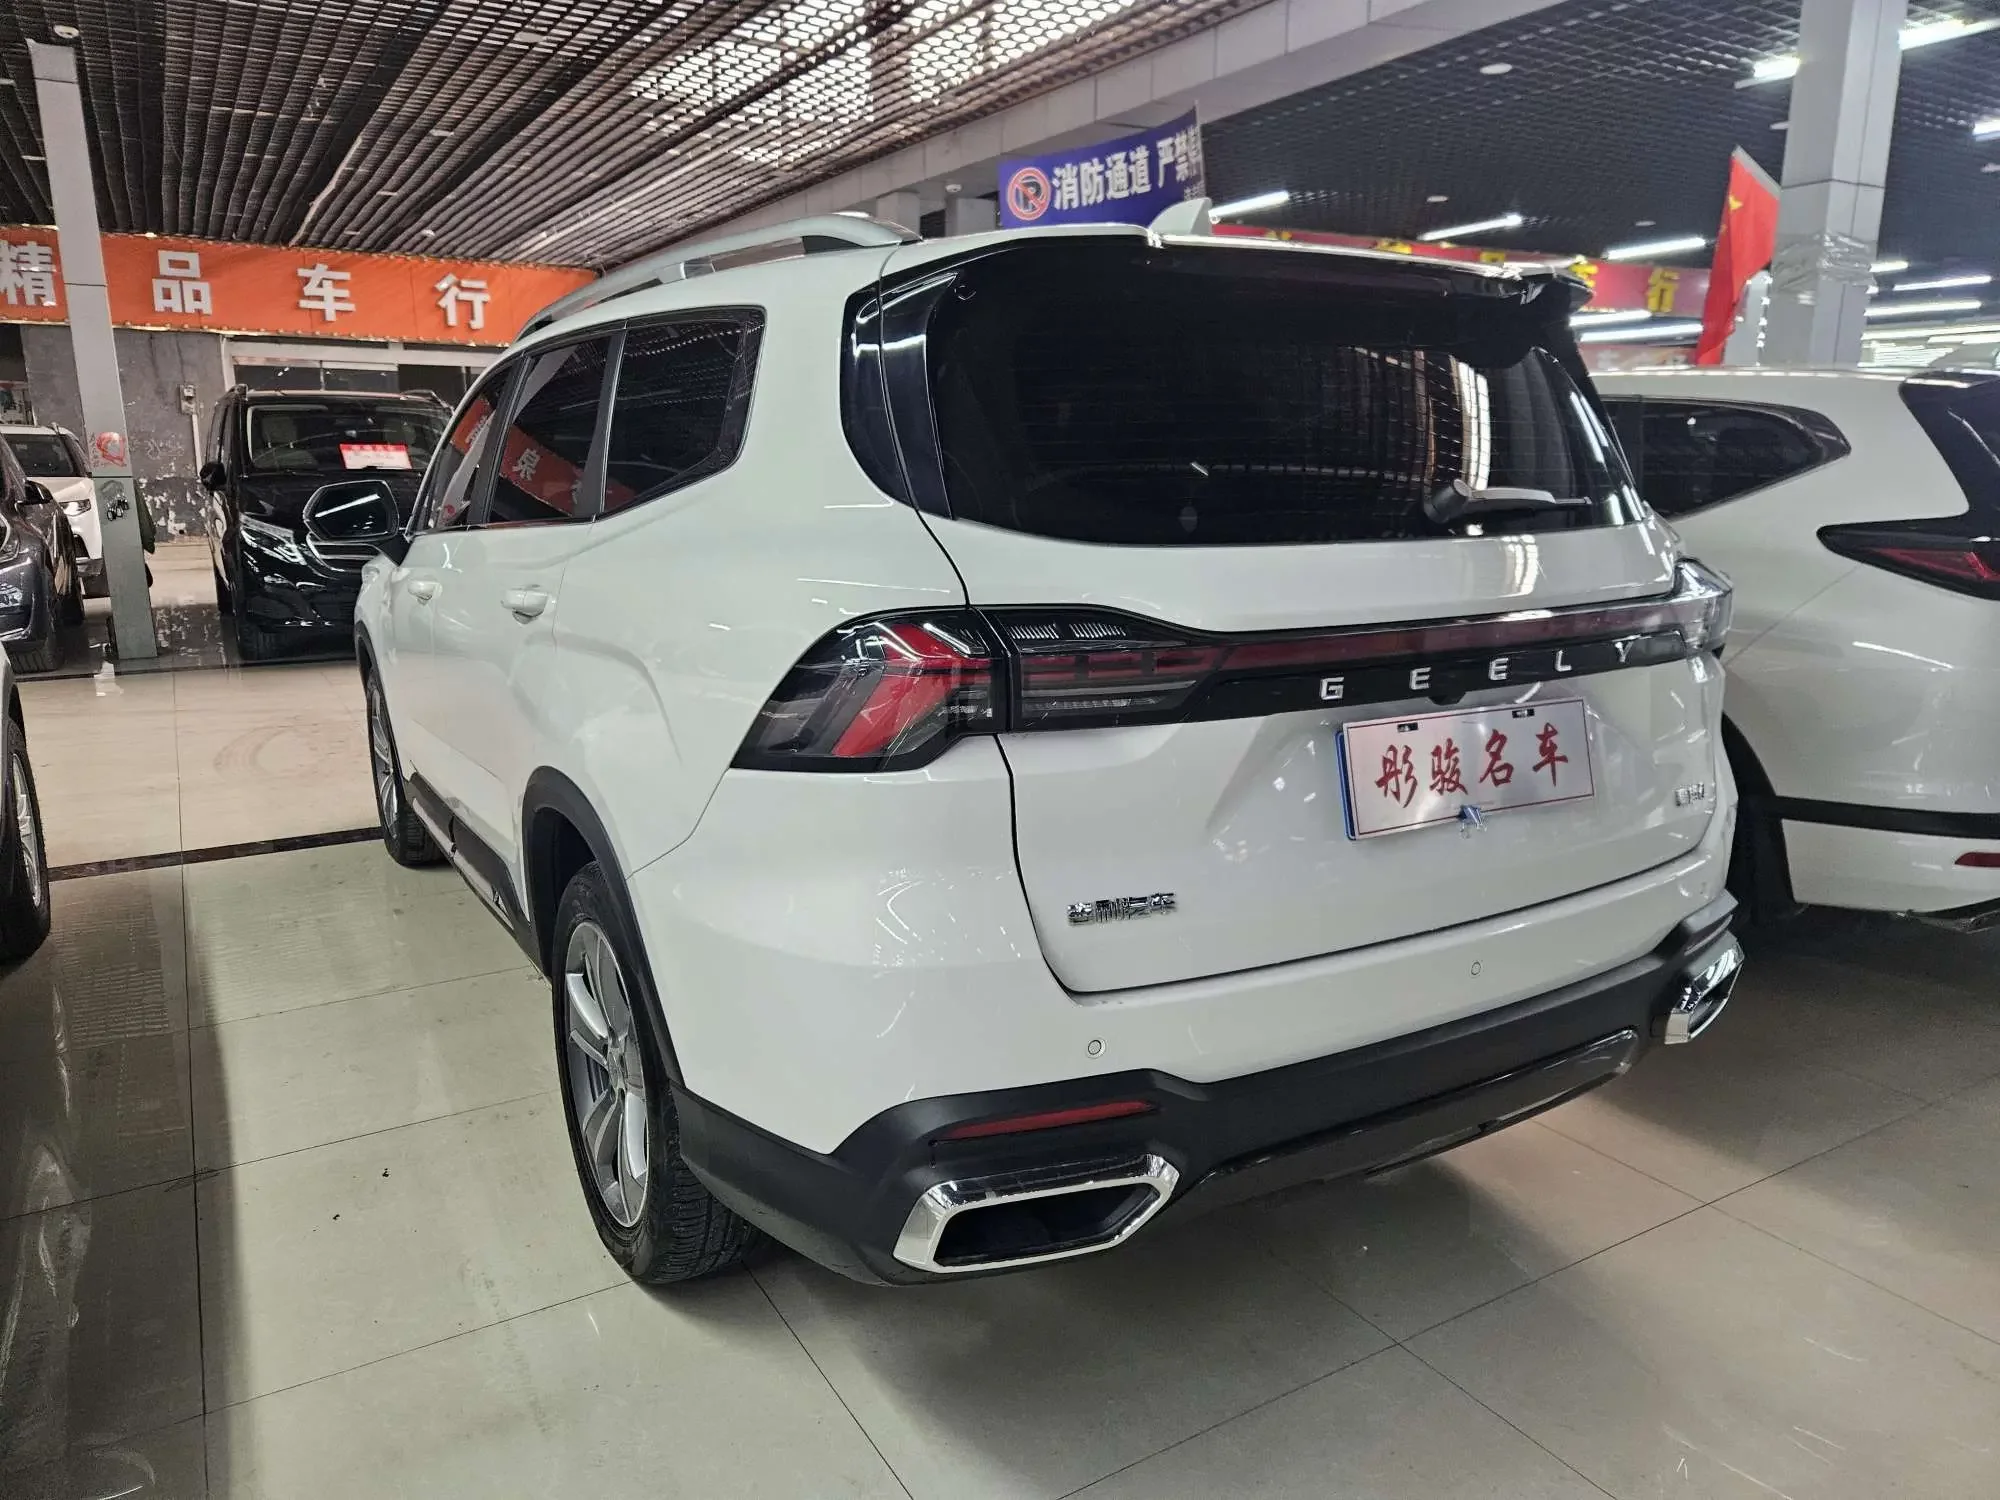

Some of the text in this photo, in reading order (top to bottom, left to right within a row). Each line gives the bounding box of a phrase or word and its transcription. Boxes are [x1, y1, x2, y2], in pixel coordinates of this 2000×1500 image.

[1052, 144, 1152, 210] 消防通道
[0, 240, 492, 330] 精品车行
[1319, 635, 1637, 700] GEELY
